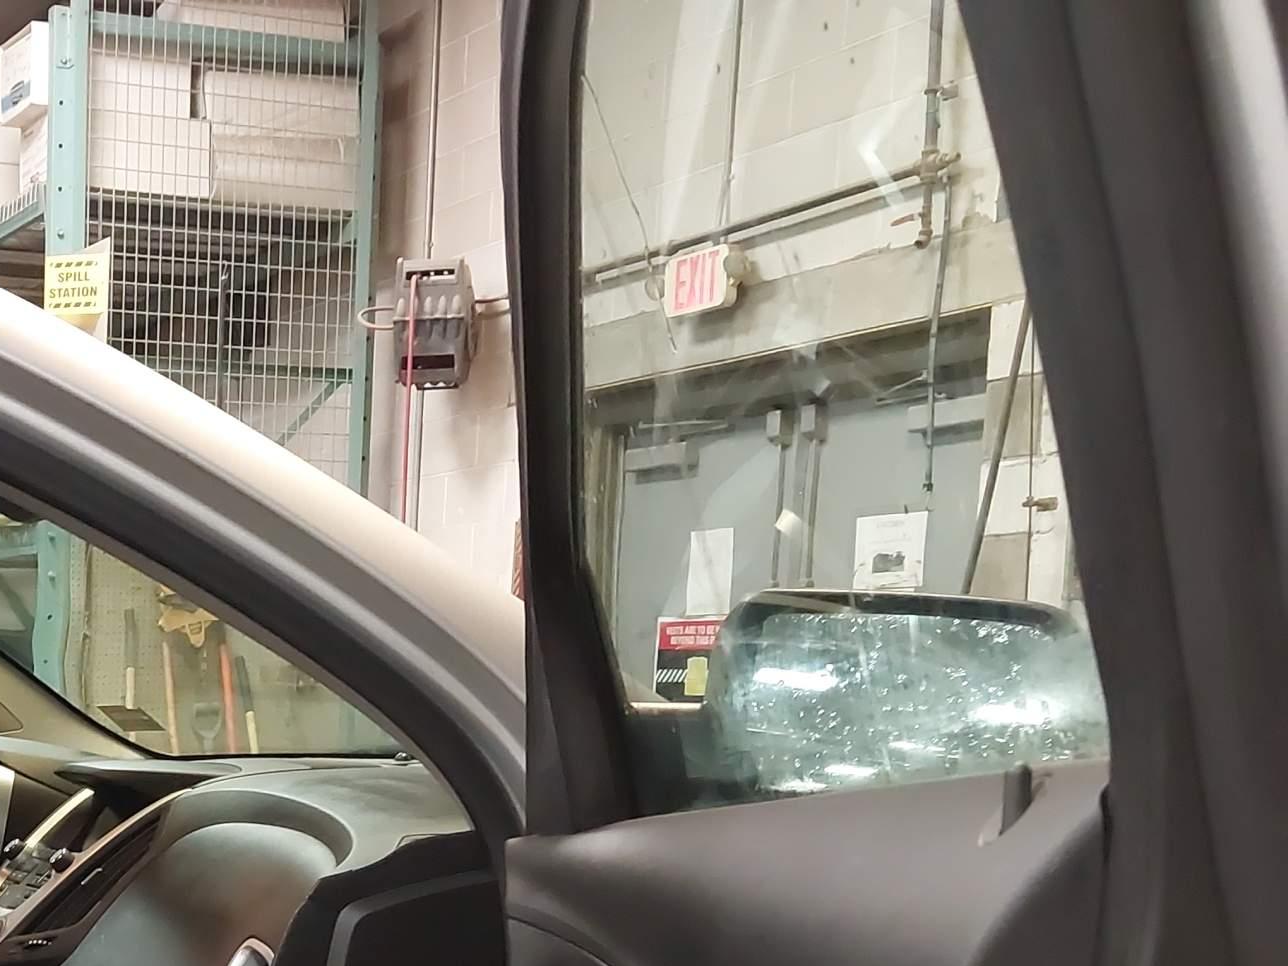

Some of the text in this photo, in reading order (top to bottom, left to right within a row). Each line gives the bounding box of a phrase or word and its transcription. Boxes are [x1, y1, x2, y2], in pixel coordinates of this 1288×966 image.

[57, 271, 90, 283] SPILL
[675, 249, 720, 310] EXIT
[49, 286, 97, 299] STATION
